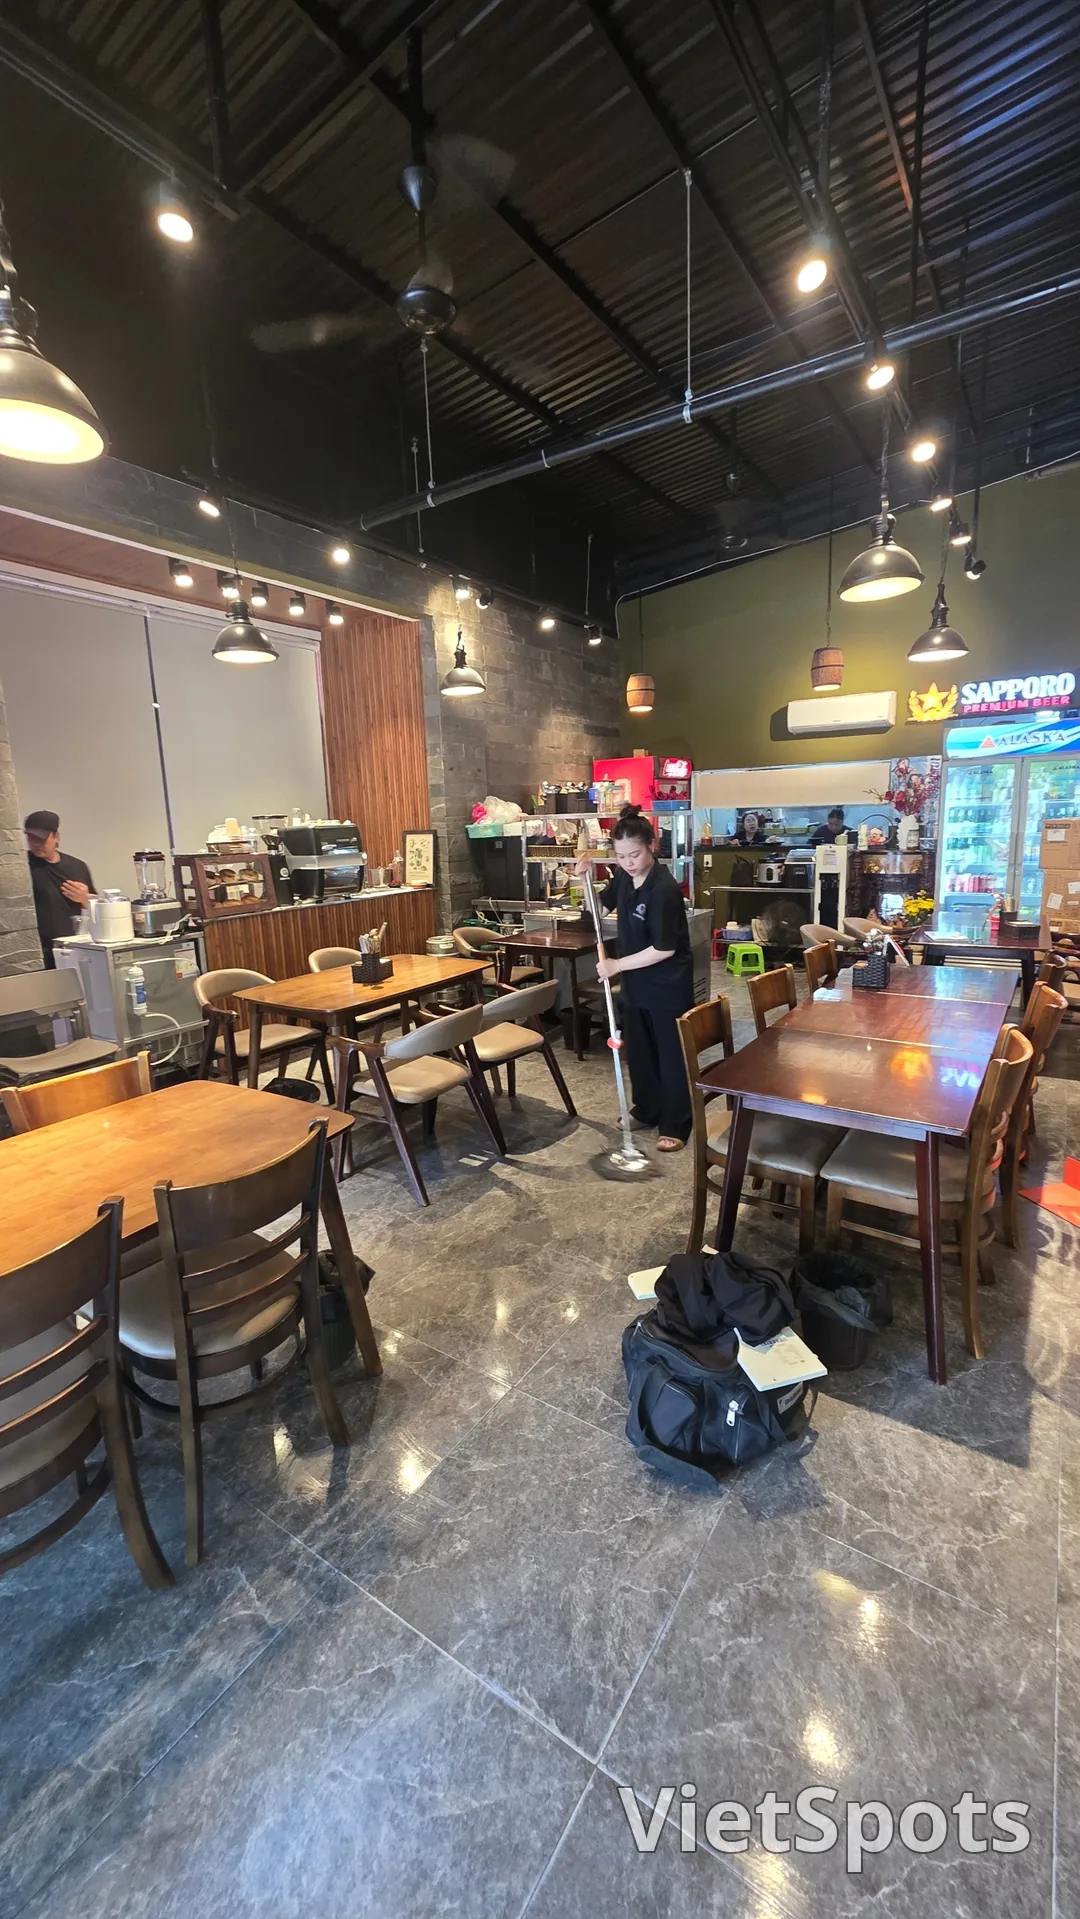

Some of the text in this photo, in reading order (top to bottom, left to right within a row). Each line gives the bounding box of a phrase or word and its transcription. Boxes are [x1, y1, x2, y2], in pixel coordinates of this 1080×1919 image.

[961, 672, 1076, 705] SAPPORO
[963, 695, 1071, 714] PREMIUM BEER
[998, 730, 1066, 746] ALASKA
